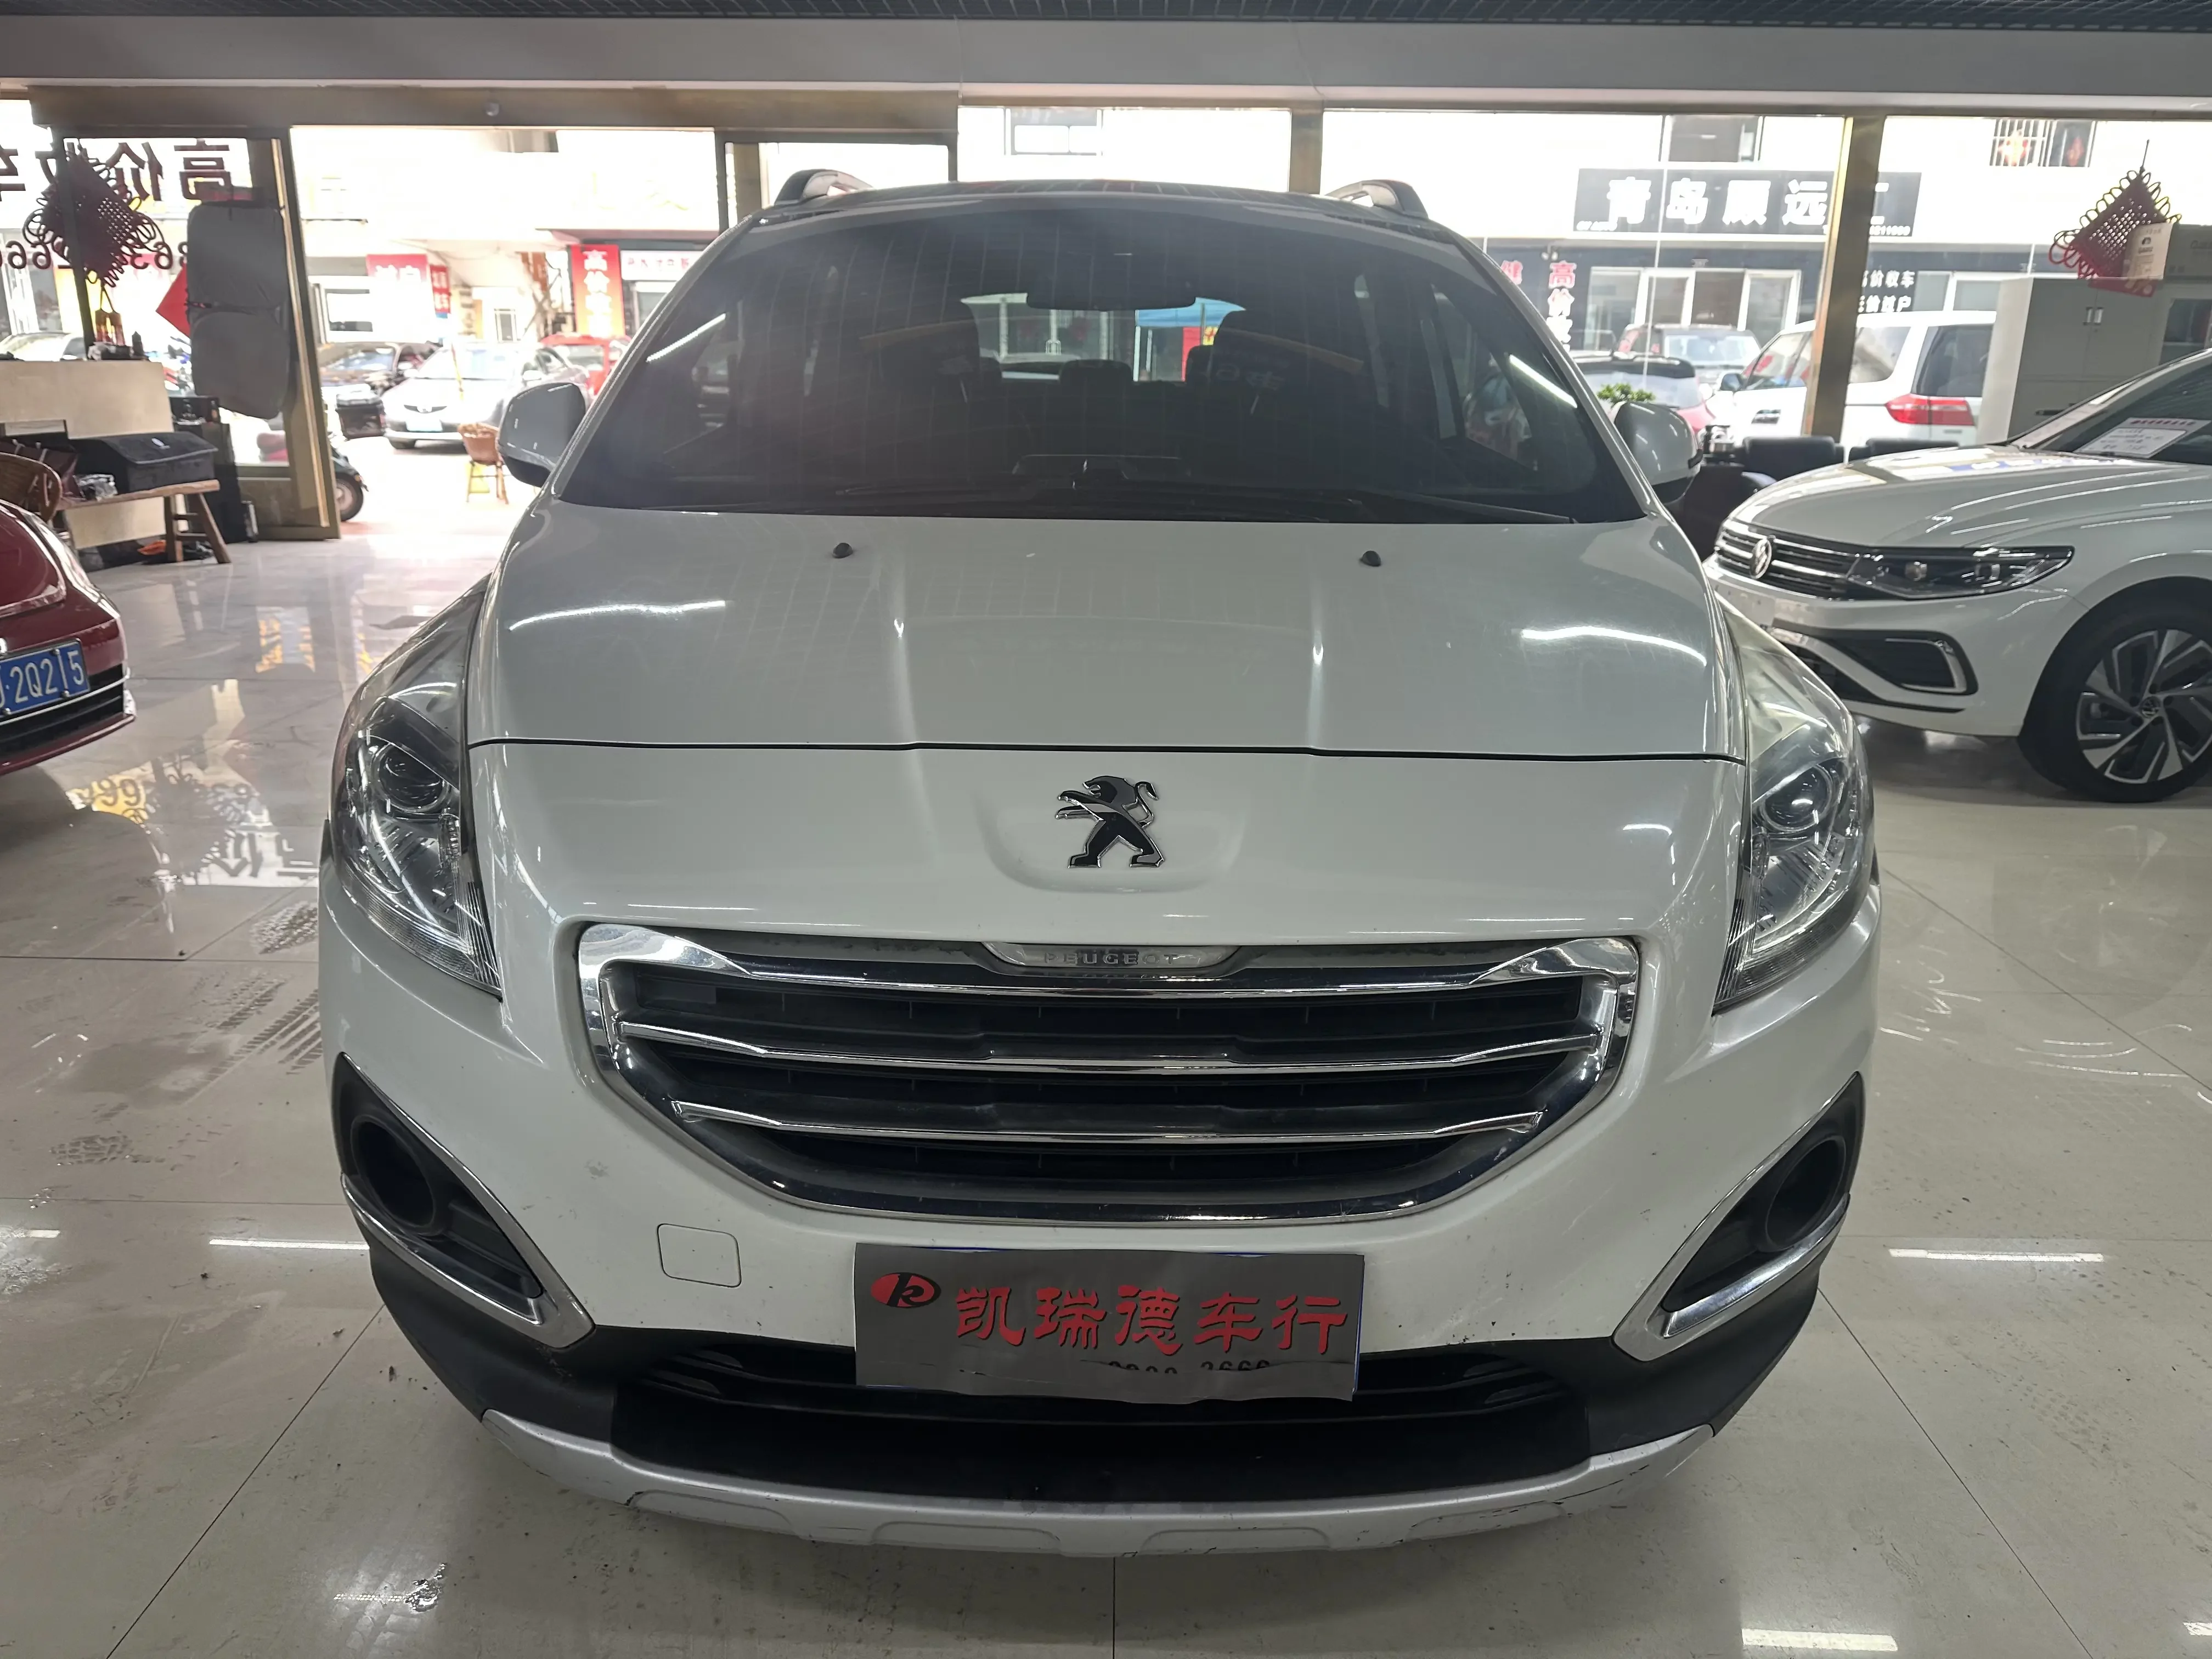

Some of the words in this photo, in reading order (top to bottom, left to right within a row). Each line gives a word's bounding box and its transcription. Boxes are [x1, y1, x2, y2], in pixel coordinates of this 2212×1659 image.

[1044, 952, 1178, 965] PEUGEOT
[955, 1284, 1348, 1356] 凯瑞德车行
